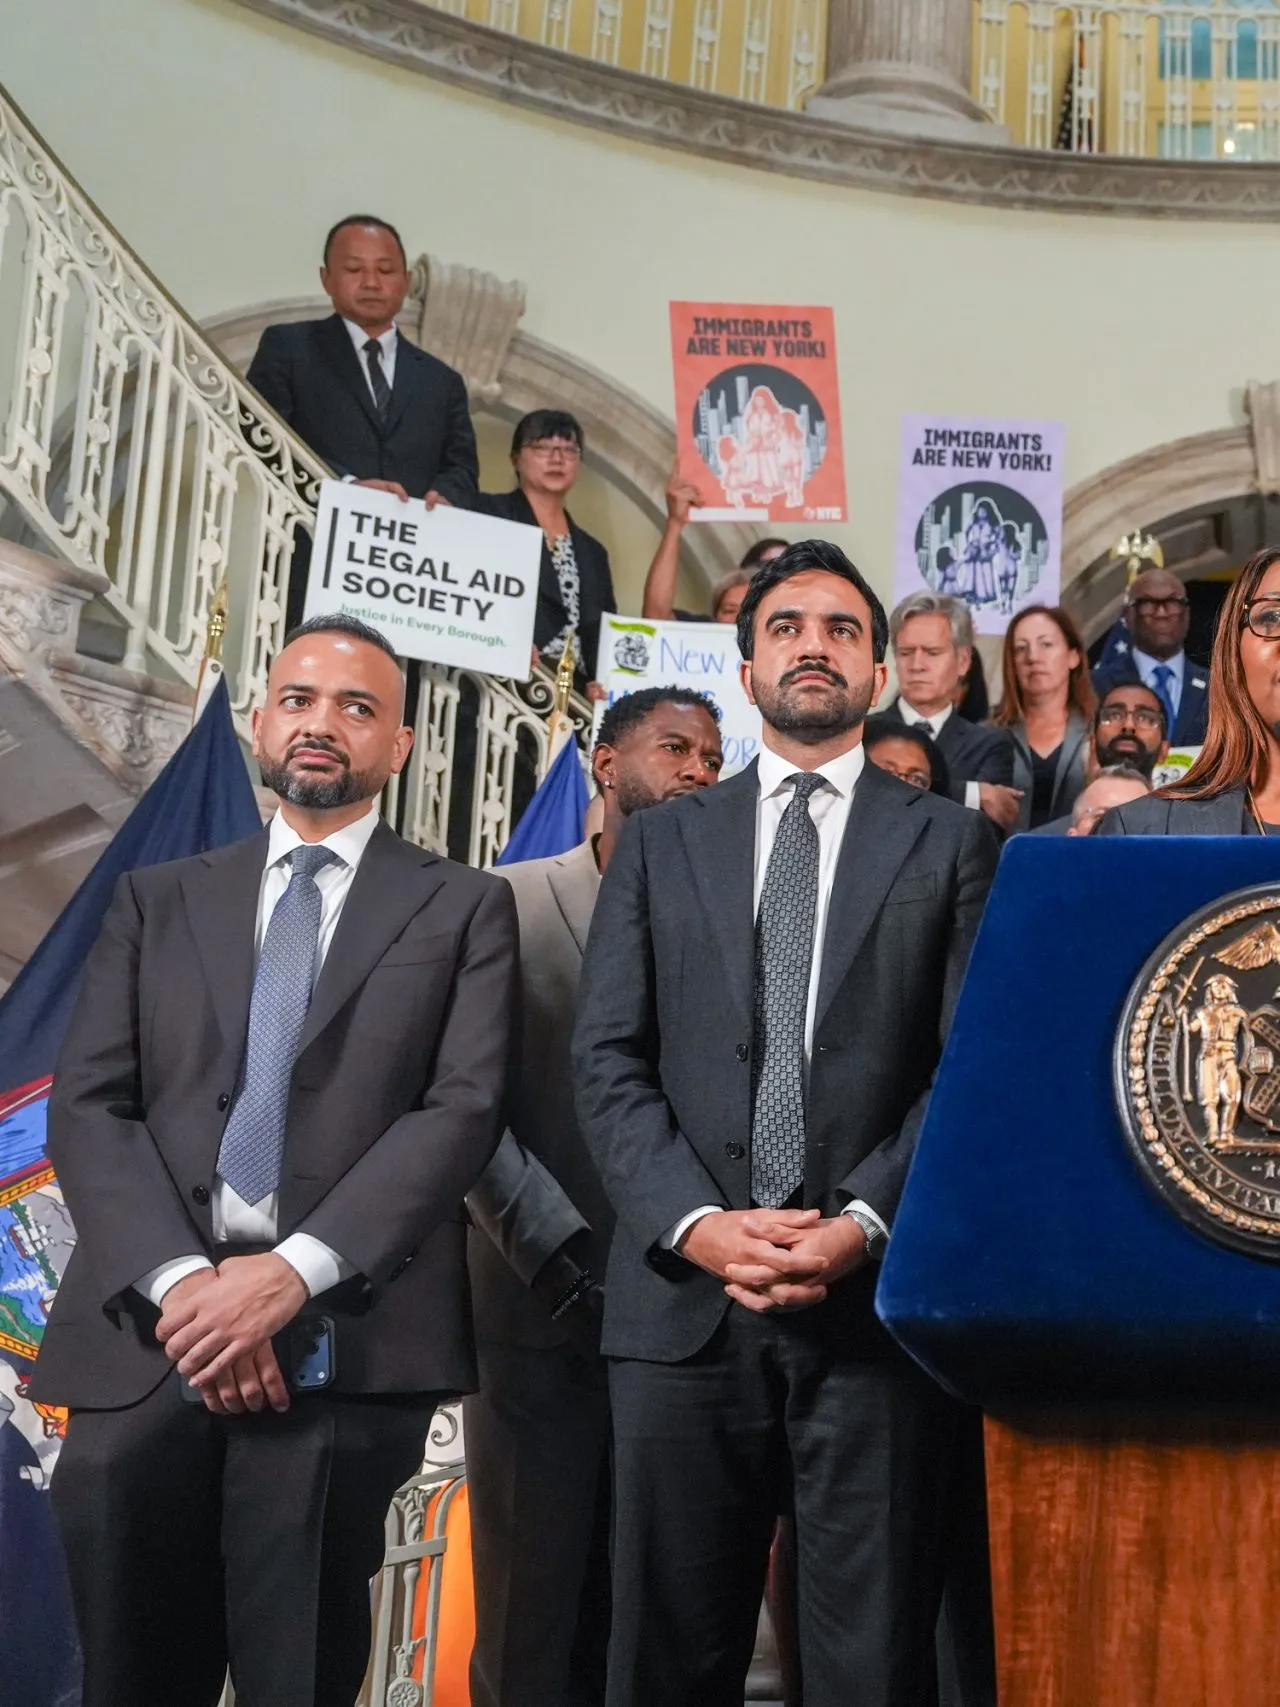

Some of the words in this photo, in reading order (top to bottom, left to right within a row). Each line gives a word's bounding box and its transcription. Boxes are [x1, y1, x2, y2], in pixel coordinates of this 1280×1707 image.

[693, 317, 812, 338] IMMIGRANTS
[687, 337, 721, 356] ARE
[727, 338, 767, 357] NEW
[772, 340, 826, 358] YORK!
[924, 429, 1042, 451] IMMIGRANTS
[912, 448, 946, 467] ARE
[952, 450, 993, 469] NEW
[999, 452, 1052, 472] YORK!
[351, 511, 418, 545] THE
[346, 541, 459, 585] LEGAL
[468, 569, 525, 598] AID
[342, 571, 494, 622] SOCIETY
[339, 603, 388, 622] Justice
[391, 613, 404, 626] in
[407, 616, 444, 636] Every
[448, 626, 507, 648] Borough.
[660, 637, 726, 675] New
